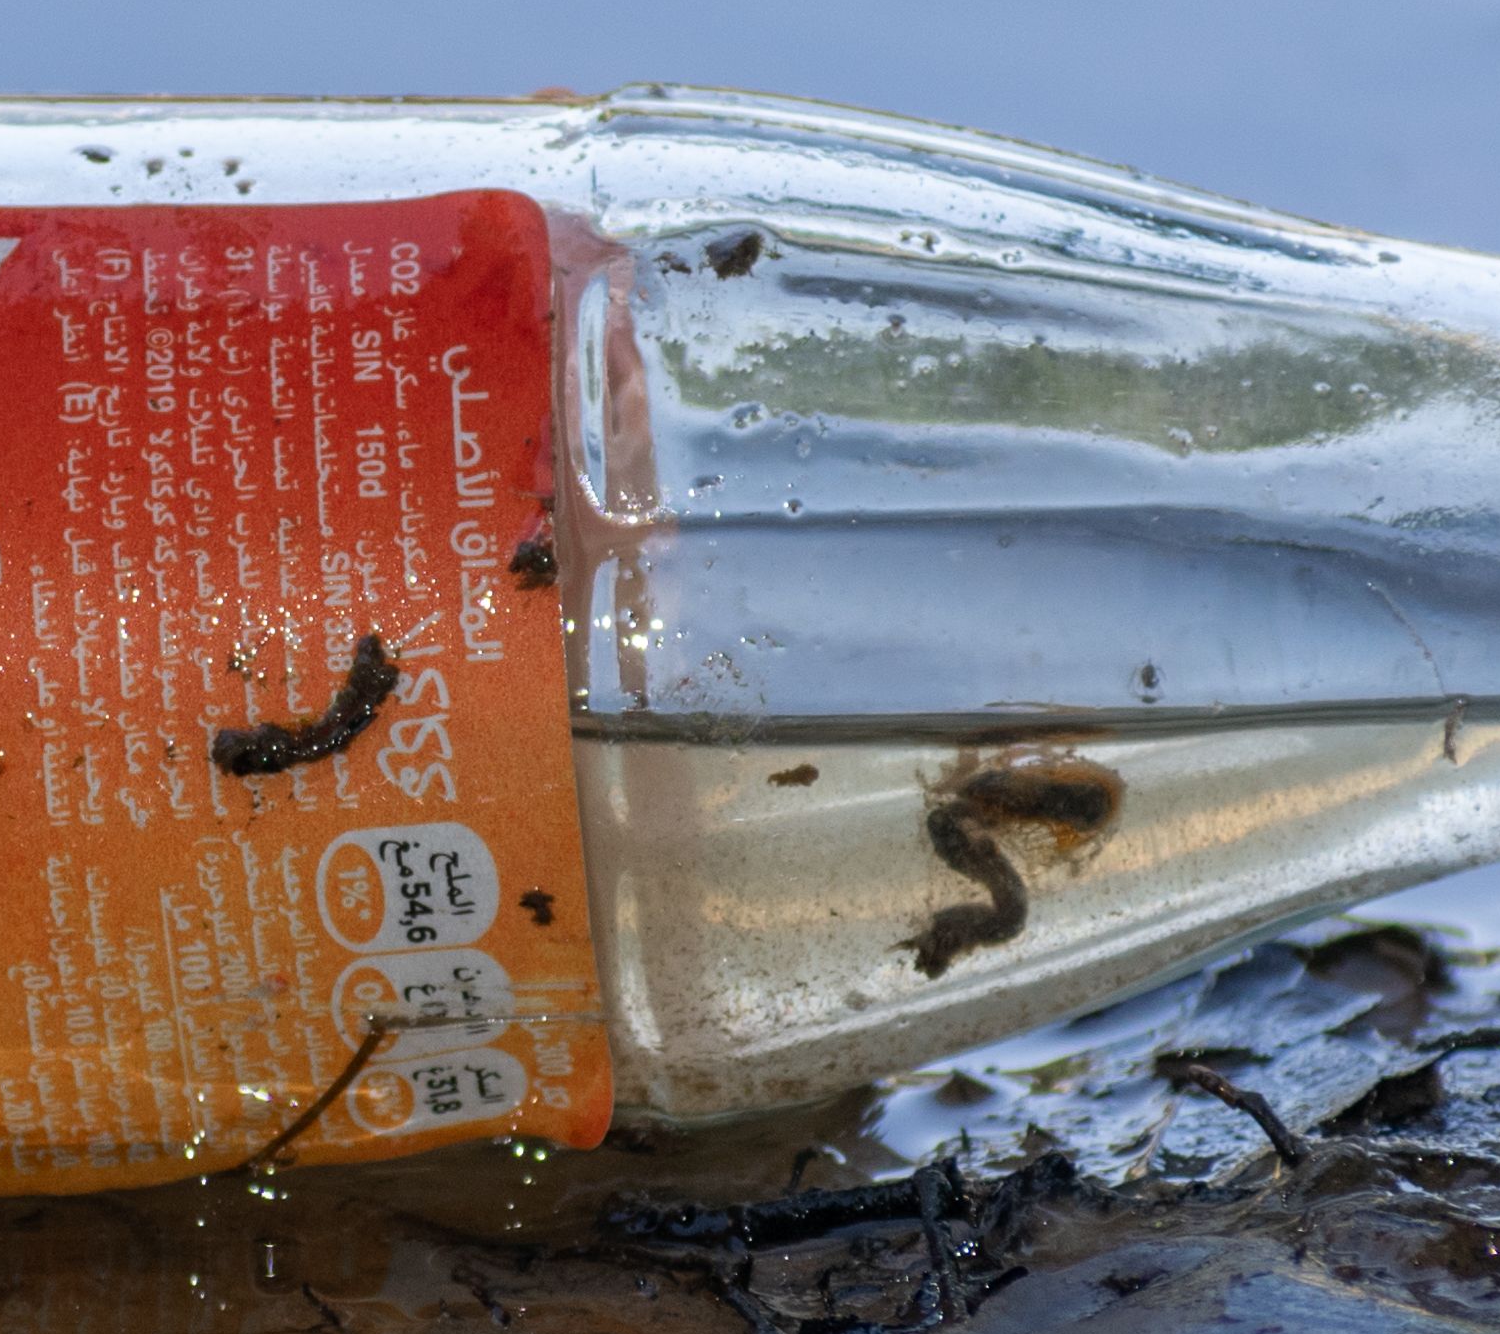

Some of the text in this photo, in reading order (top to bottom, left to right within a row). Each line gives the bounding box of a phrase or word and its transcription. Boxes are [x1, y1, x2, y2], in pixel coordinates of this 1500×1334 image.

[94, 247, 131, 282] (F)
[224, 246, 253, 272] 31
[258, 244, 291, 322] بواسطة
[342, 241, 372, 296] معدل
[177, 319, 212, 378] ولاية
[382, 306, 416, 341] غاز
[56, 380, 96, 423] (E)
[260, 337, 295, 420] التعبئة
[93, 385, 133, 448] تاريخ
[182, 387, 214, 465] تليلات
[217, 386, 256, 500] الجزائري
[142, 427, 176, 526] كوكاكولا
[271, 436, 299, 490] تمت
[354, 424, 386, 497] 150d
[180, 478, 213, 537] وادي
[427, 345, 503, 661] المذاق الأصلي
[60, 527, 97, 576] قبل
[146, 535, 177, 601] شركة
[323, 617, 353, 672] 338
[28, 656, 59, 708] على
[116, 710, 147, 775] مكان
[428, 850, 476, 917] الملح
[178, 939, 211, 991] 100
